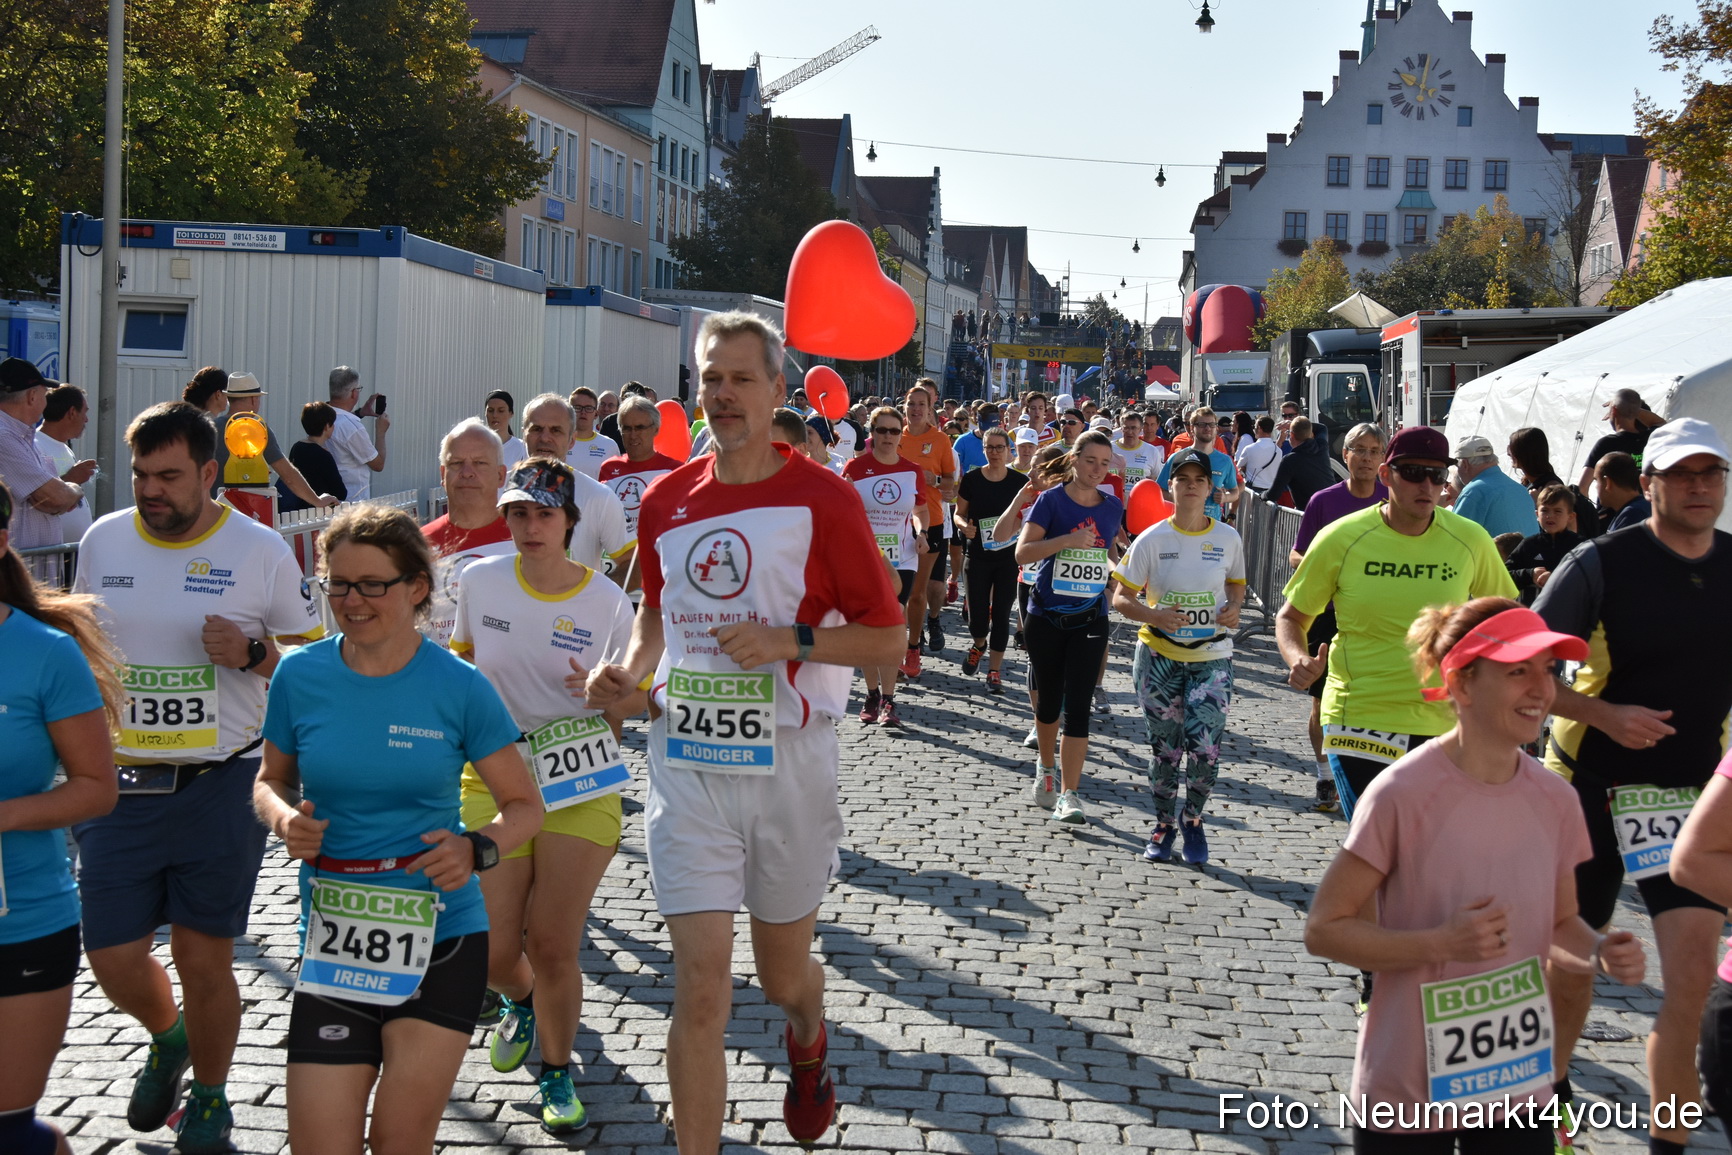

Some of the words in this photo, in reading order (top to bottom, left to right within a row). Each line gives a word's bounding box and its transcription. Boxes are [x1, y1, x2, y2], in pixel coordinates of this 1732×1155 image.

[1028, 348, 1066, 358] START
[1061, 549, 1104, 560] BOCK
[187, 562, 210, 575] 20
[1061, 563, 1103, 580] 2089
[1364, 561, 1438, 579] CRAFT
[103, 576, 134, 585] BOCK
[186, 576, 236, 587] Neumarkter
[1071, 584, 1091, 592] LISA
[184, 585, 225, 596] Stadtlauf
[1161, 592, 1211, 605] BOCK
[483, 615, 510, 629] BOCK
[554, 618, 573, 633] 20
[671, 612, 713, 624] LAUFEN
[720, 613, 742, 623] MIT
[551, 640, 584, 654] Stadtlauf
[552, 632, 593, 647] Neumarkter
[120, 668, 208, 690] BOCK
[672, 672, 765, 699] BOCK
[130, 697, 205, 726] 1383
[677, 704, 762, 739] 2456
[398, 726, 444, 740] PFLEIDERER
[534, 716, 605, 750] BOCK
[388, 738, 413, 749] Irene
[1330, 738, 1397, 757] CHRISTIAN
[543, 738, 609, 779] 2011
[682, 744, 755, 763] RÜDIGER
[575, 777, 598, 793] RIA
[1617, 788, 1697, 811] BOCK
[1624, 814, 1688, 845] 242
[1637, 848, 1672, 867] NOR
[319, 884, 425, 922] BOCK
[320, 920, 414, 966] 2481
[421, 936, 428, 944] D
[333, 969, 391, 991] IRENE
[1432, 964, 1539, 1018] BOCK
[1444, 1007, 1540, 1065] 2649
[1450, 1057, 1540, 1095] STEFANIE
